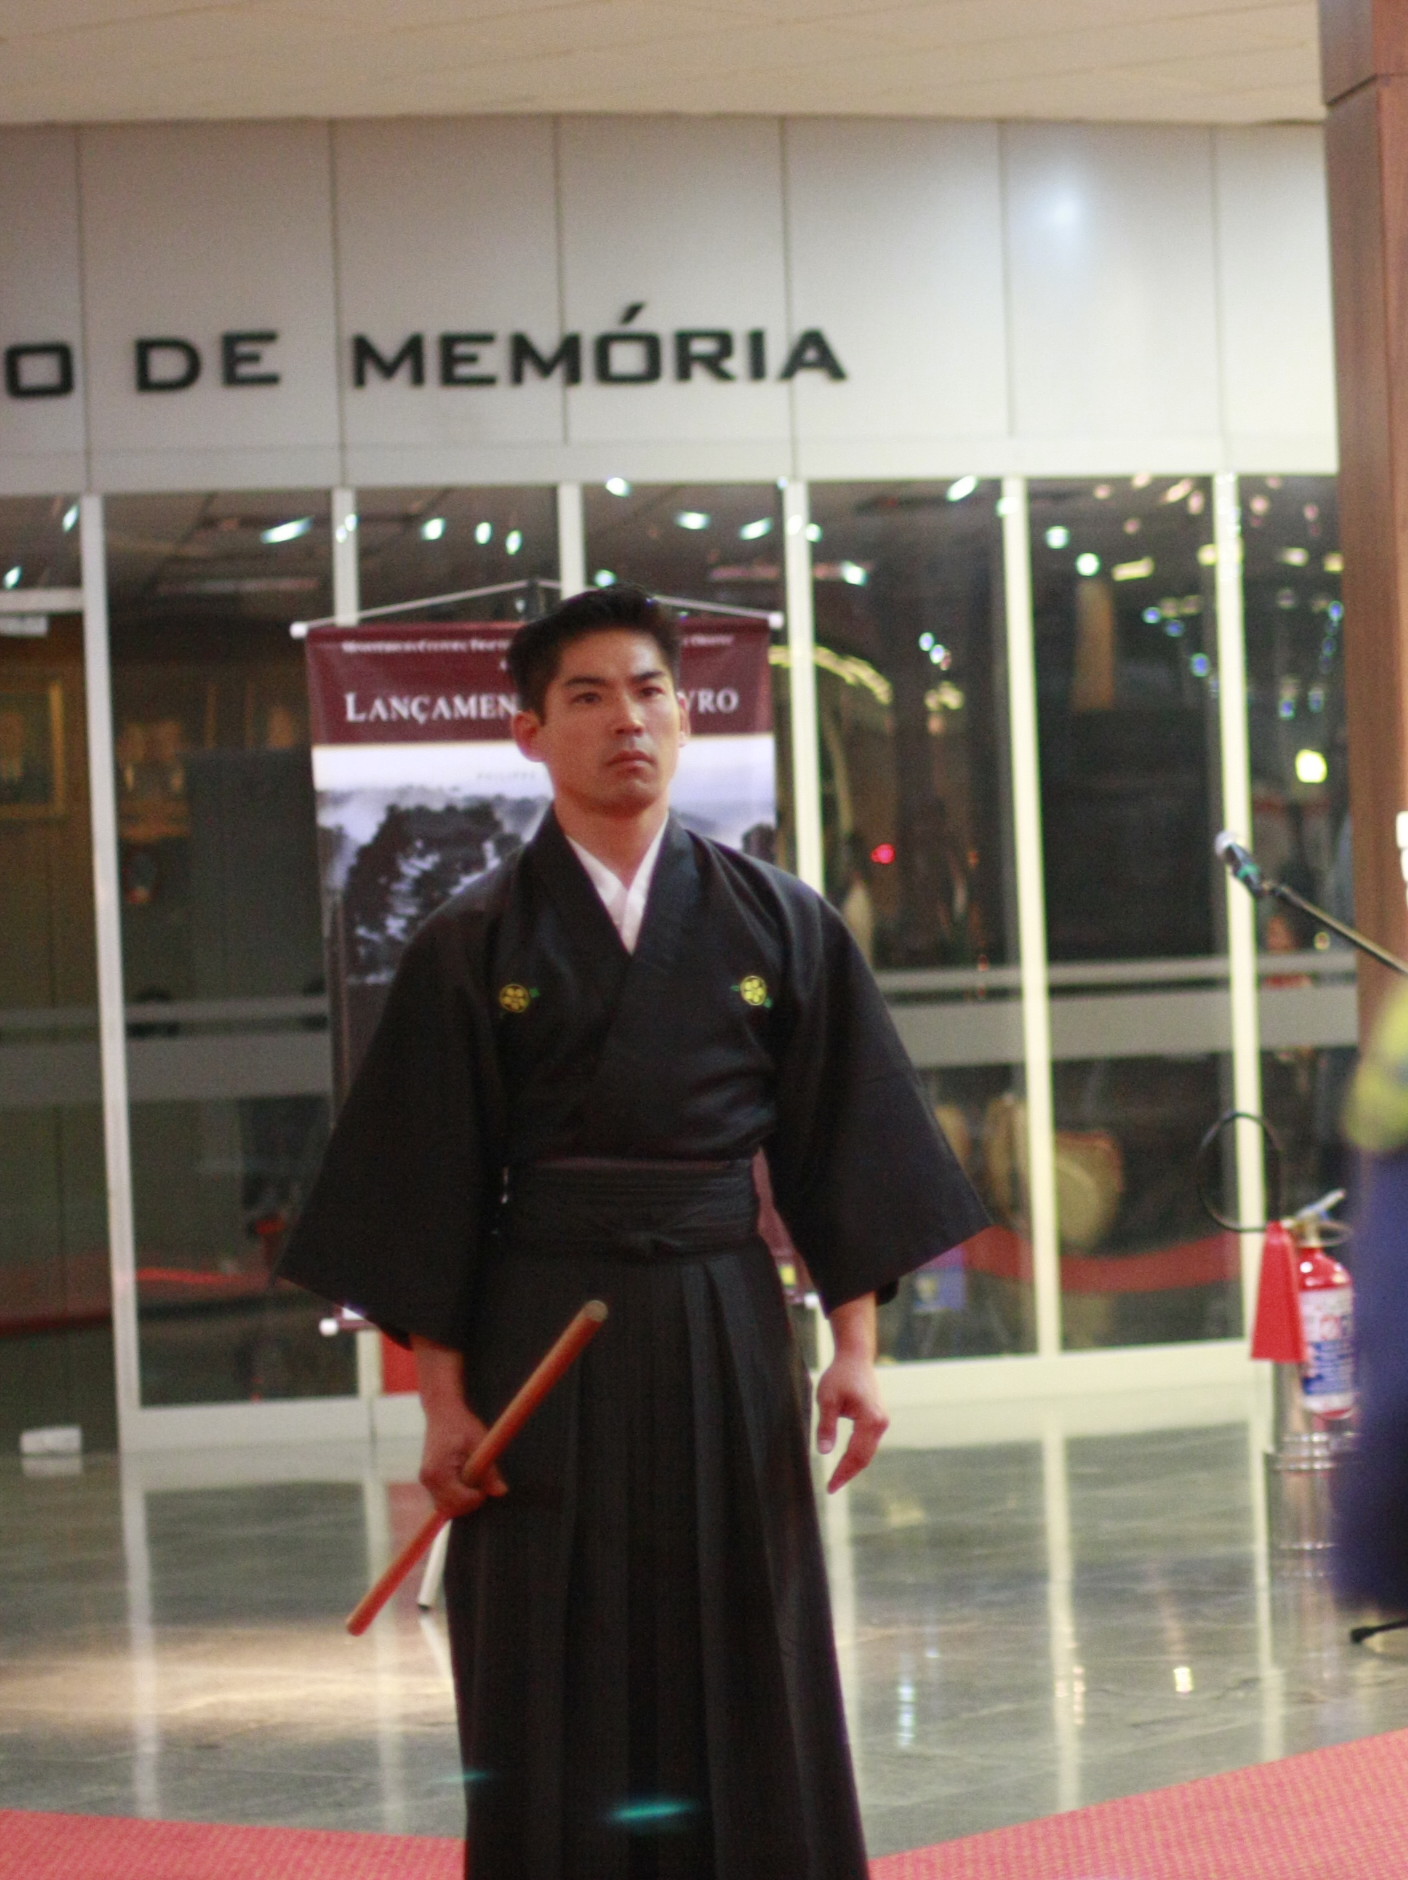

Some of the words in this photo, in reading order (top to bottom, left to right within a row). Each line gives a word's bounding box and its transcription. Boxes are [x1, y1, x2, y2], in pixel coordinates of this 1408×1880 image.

[5, 341, 75, 398] O
[134, 331, 282, 393] DE
[352, 302, 848, 388] MEMÓRIA
